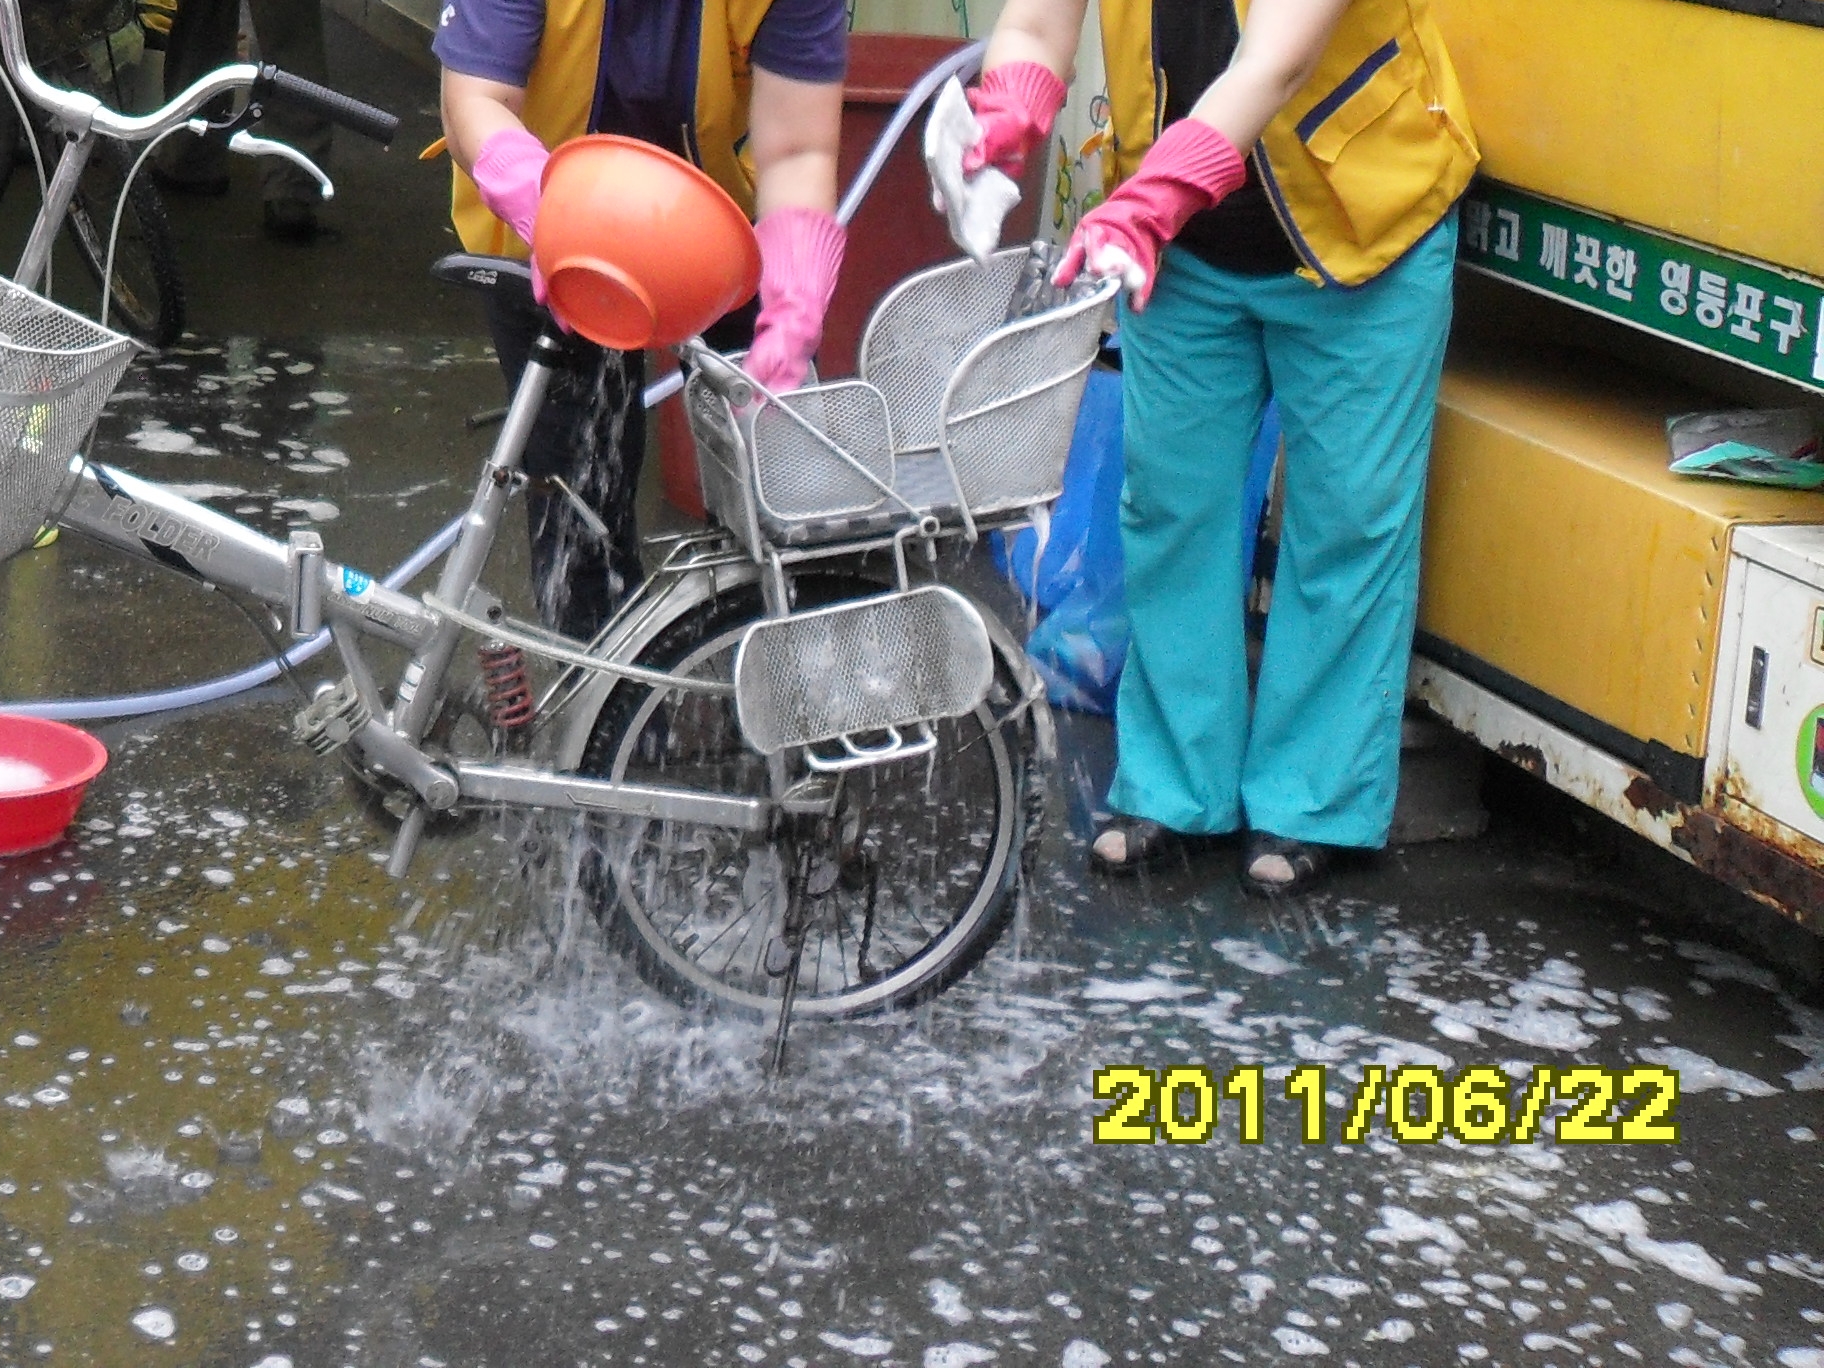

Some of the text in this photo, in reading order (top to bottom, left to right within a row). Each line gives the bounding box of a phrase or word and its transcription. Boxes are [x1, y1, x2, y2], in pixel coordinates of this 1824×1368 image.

[1539, 222, 1637, 302] 깨끗한
[1659, 259, 1808, 356] 영등포구
[101, 493, 221, 562] FOLDER
